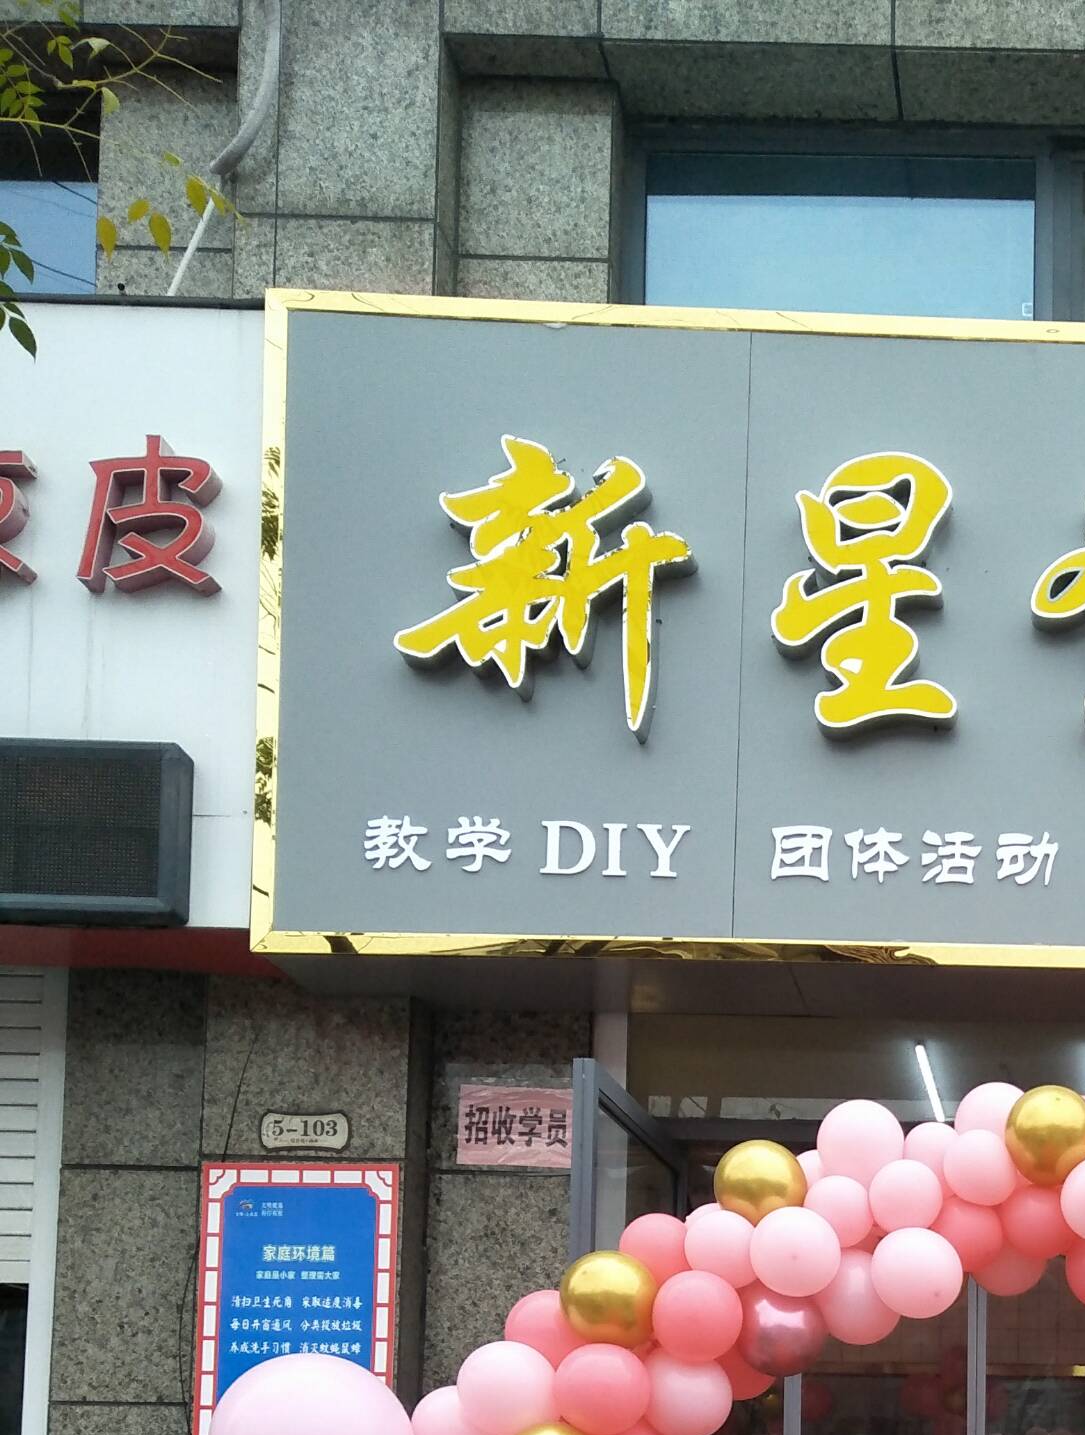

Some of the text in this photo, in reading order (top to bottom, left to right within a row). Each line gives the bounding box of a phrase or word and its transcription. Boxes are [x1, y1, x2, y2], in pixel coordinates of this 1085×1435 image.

[769, 824, 1060, 887] 团体活动
[271, 1119, 338, 1137] 5-103
[464, 1104, 569, 1149] 招收学员
[262, 1244, 336, 1262] 家庭环境篇
